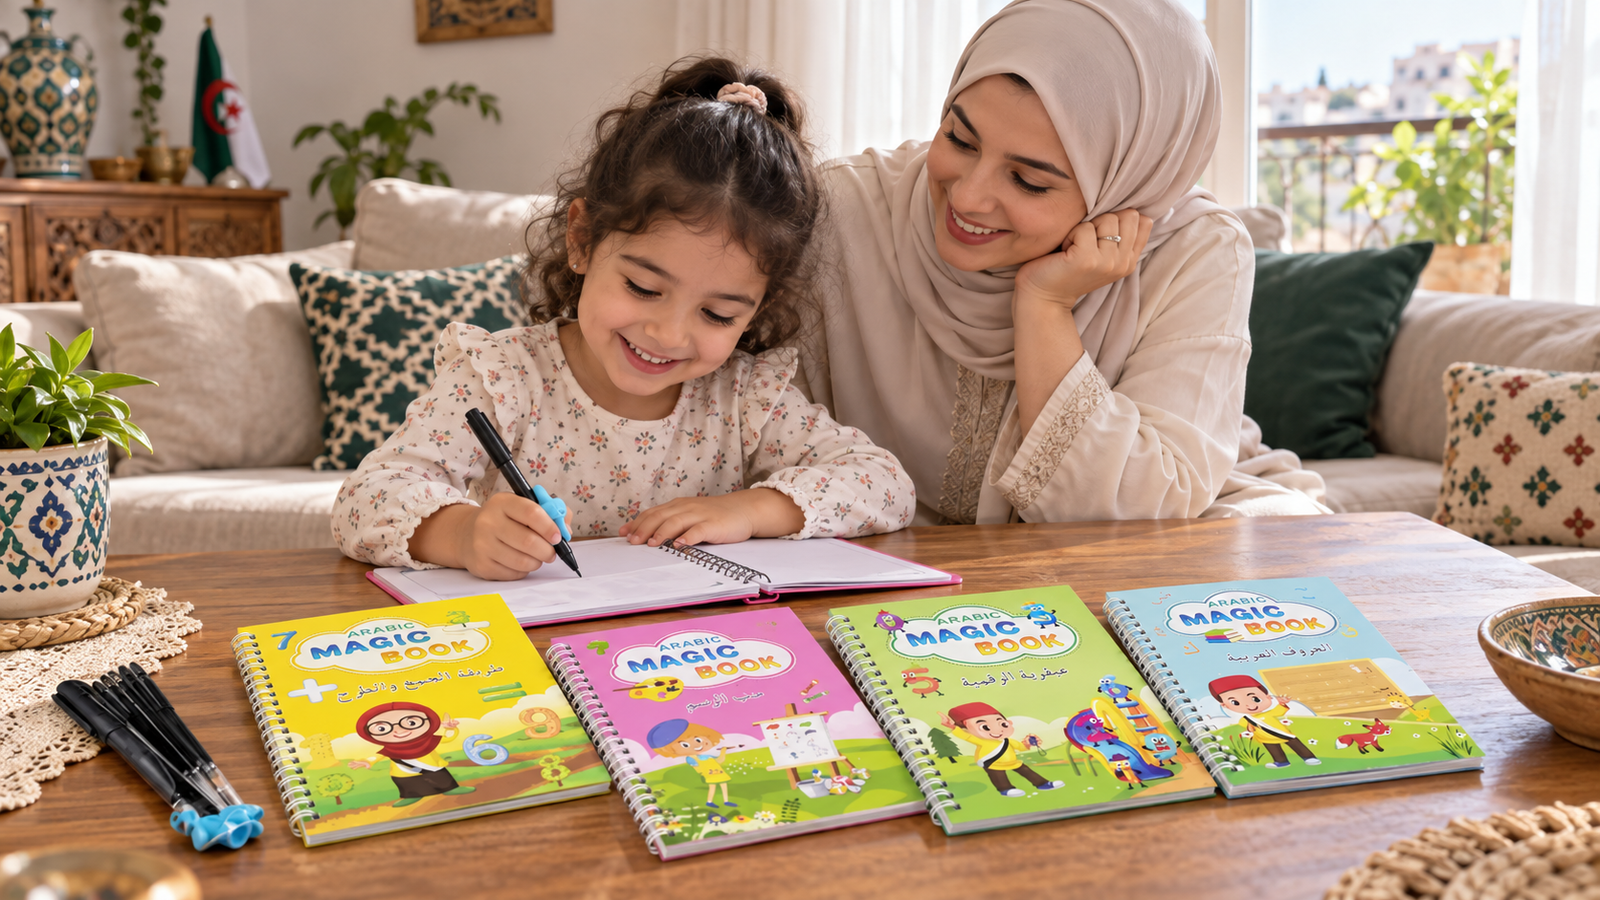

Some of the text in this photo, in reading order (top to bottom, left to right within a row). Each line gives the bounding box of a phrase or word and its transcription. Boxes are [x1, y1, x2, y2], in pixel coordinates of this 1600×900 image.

[1208, 596, 1267, 608] ARABIC
[937, 611, 1001, 626] ARABIC
[1179, 605, 1285, 626] MAGIC
[1244, 617, 1326, 636] BOOK
[271, 630, 297, 650] 7
[347, 622, 415, 639] ARABIC
[905, 621, 1020, 647] MAGIC
[310, 630, 431, 660] MAGIC
[380, 640, 474, 665] BOOK
[659, 636, 721, 652] ARABIC
[974, 633, 1065, 656] BOOK
[627, 645, 739, 673] MAGIC
[694, 655, 781, 680] BOOK
[463, 734, 509, 766] 6
